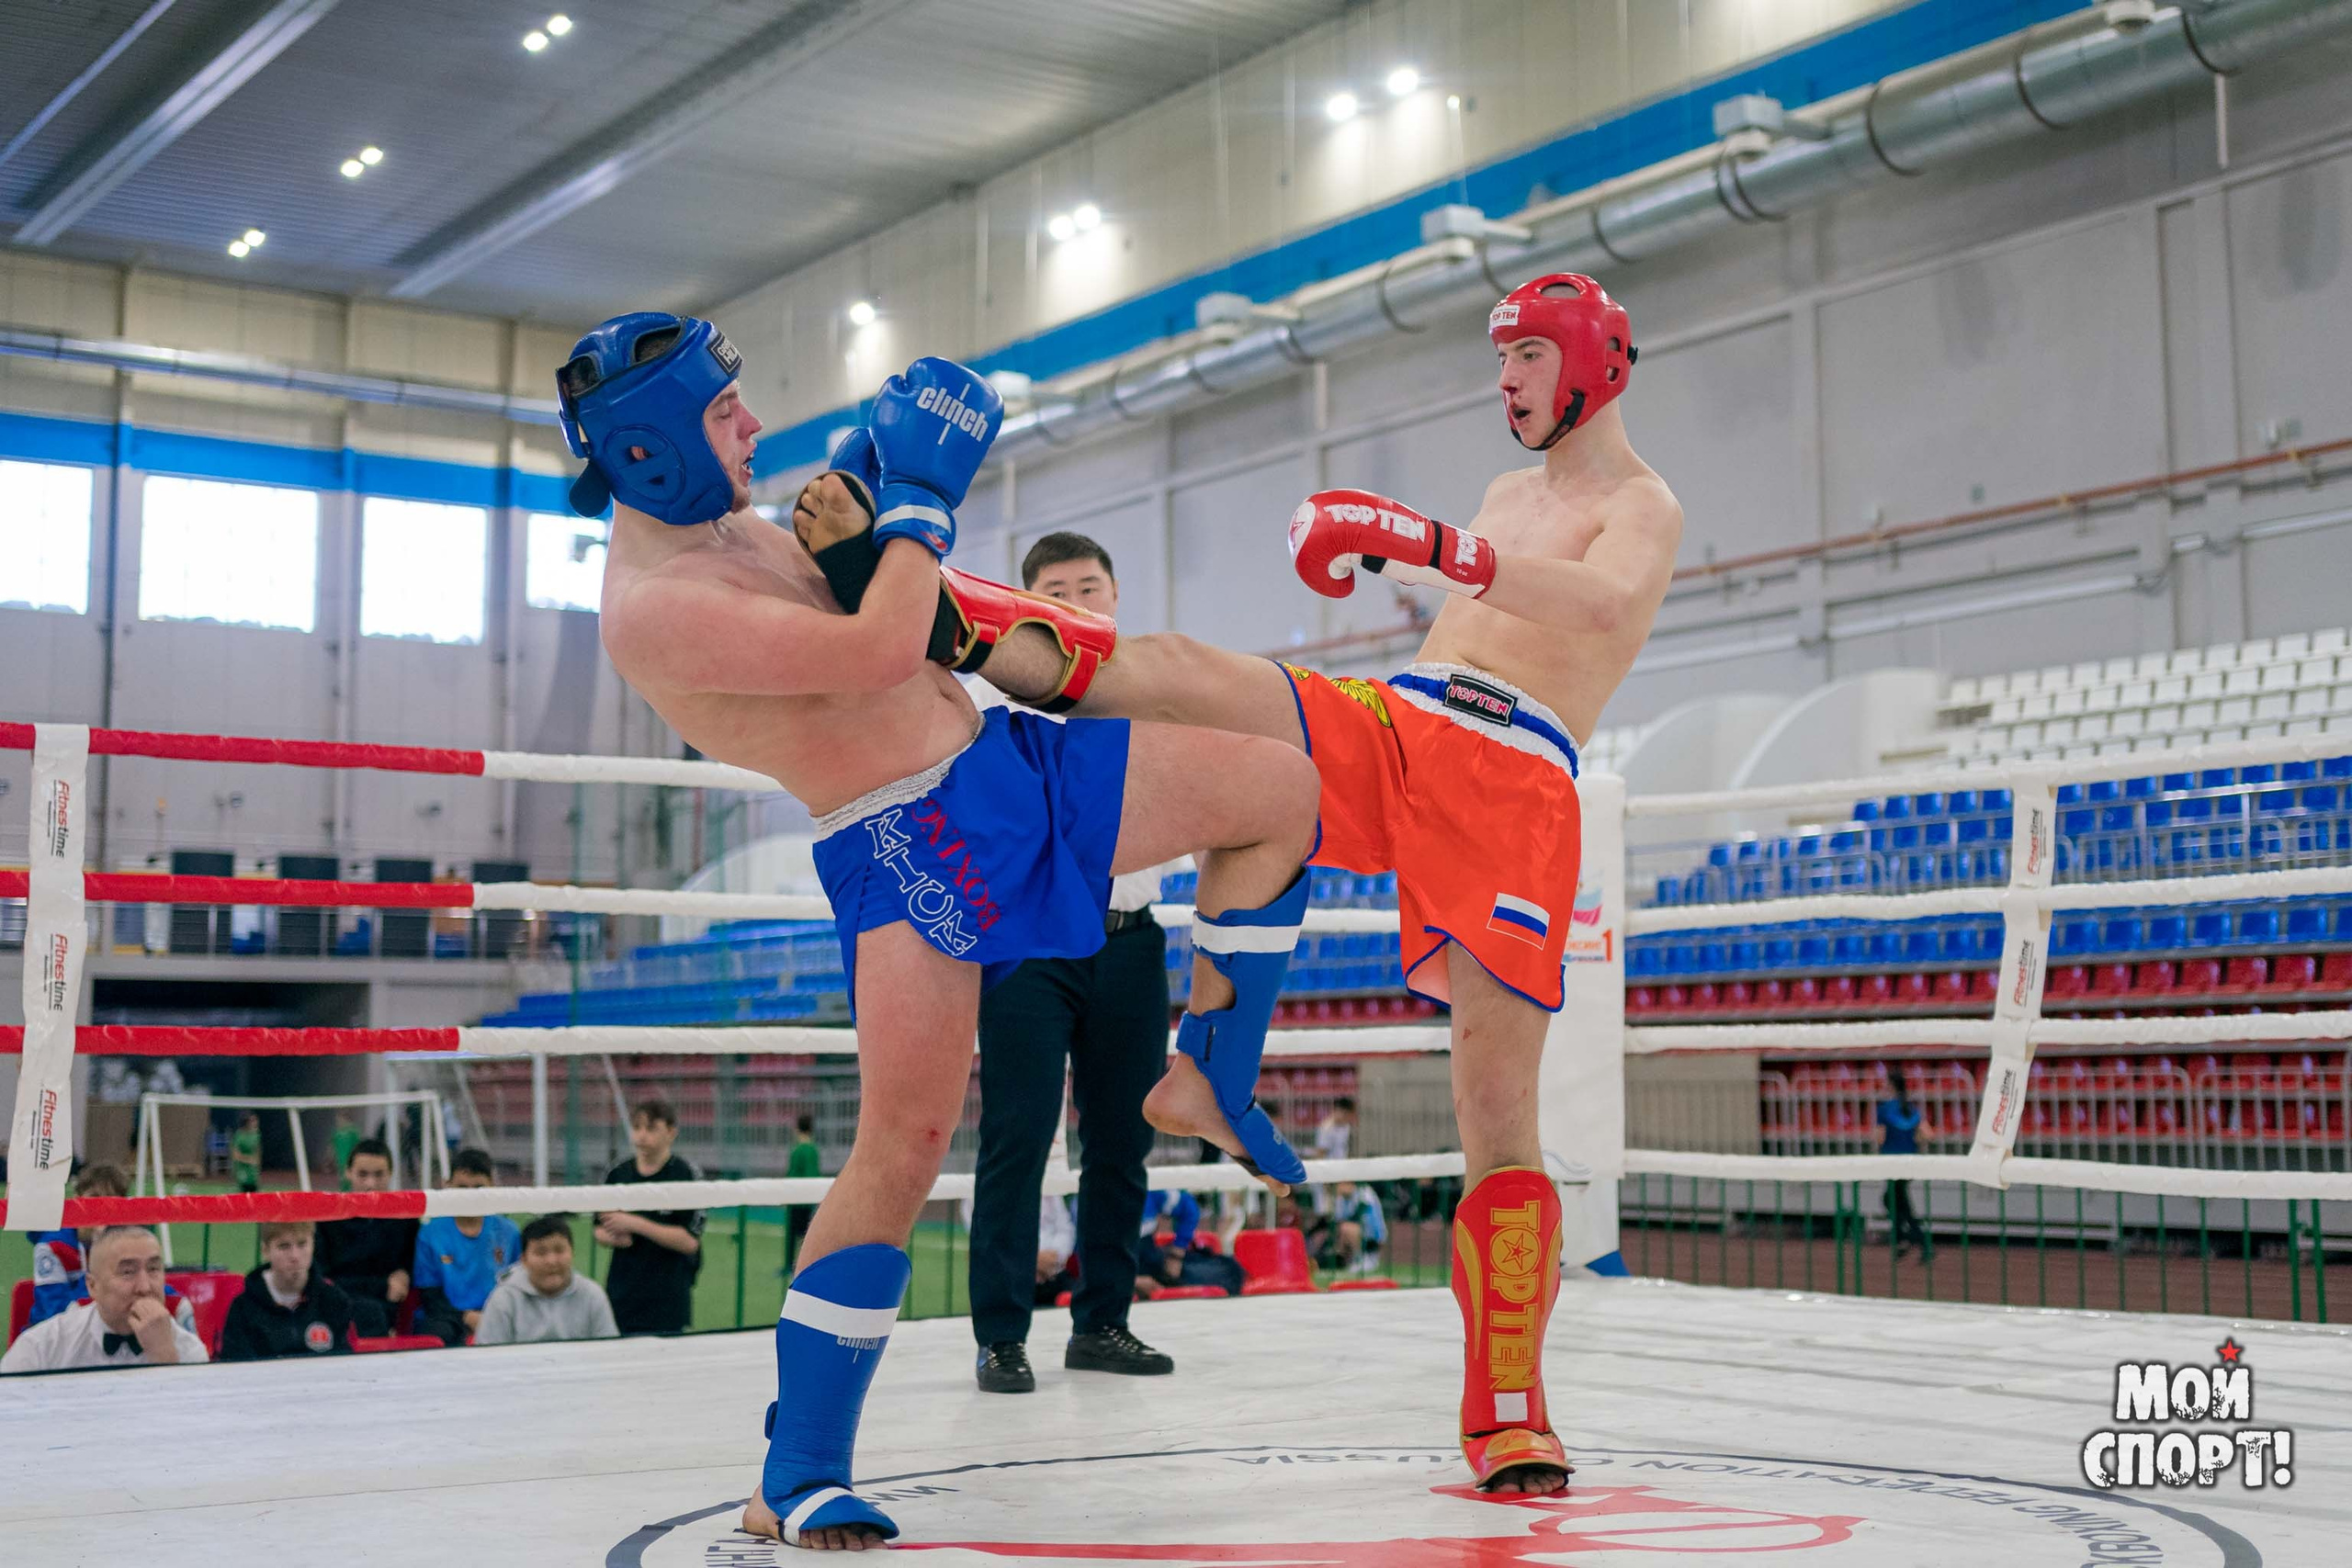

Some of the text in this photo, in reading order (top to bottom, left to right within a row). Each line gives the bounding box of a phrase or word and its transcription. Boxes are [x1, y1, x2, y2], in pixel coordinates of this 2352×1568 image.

[1502, 310, 1516, 320] TEN
[917, 387, 989, 443] clinch
[1324, 503, 1426, 543] TOP TEN
[1450, 685, 1510, 716] TOP TEN
[56, 779, 70, 858] Fitnestime
[865, 808, 978, 955] KICK
[911, 799, 1001, 931] BOXING
[54, 933, 68, 1011] Fitnestime
[40, 1089, 57, 1170] Fitnestime
[1489, 1200, 1541, 1391] TOP TEN
[1223, 1454, 1464, 1467] USSIA
